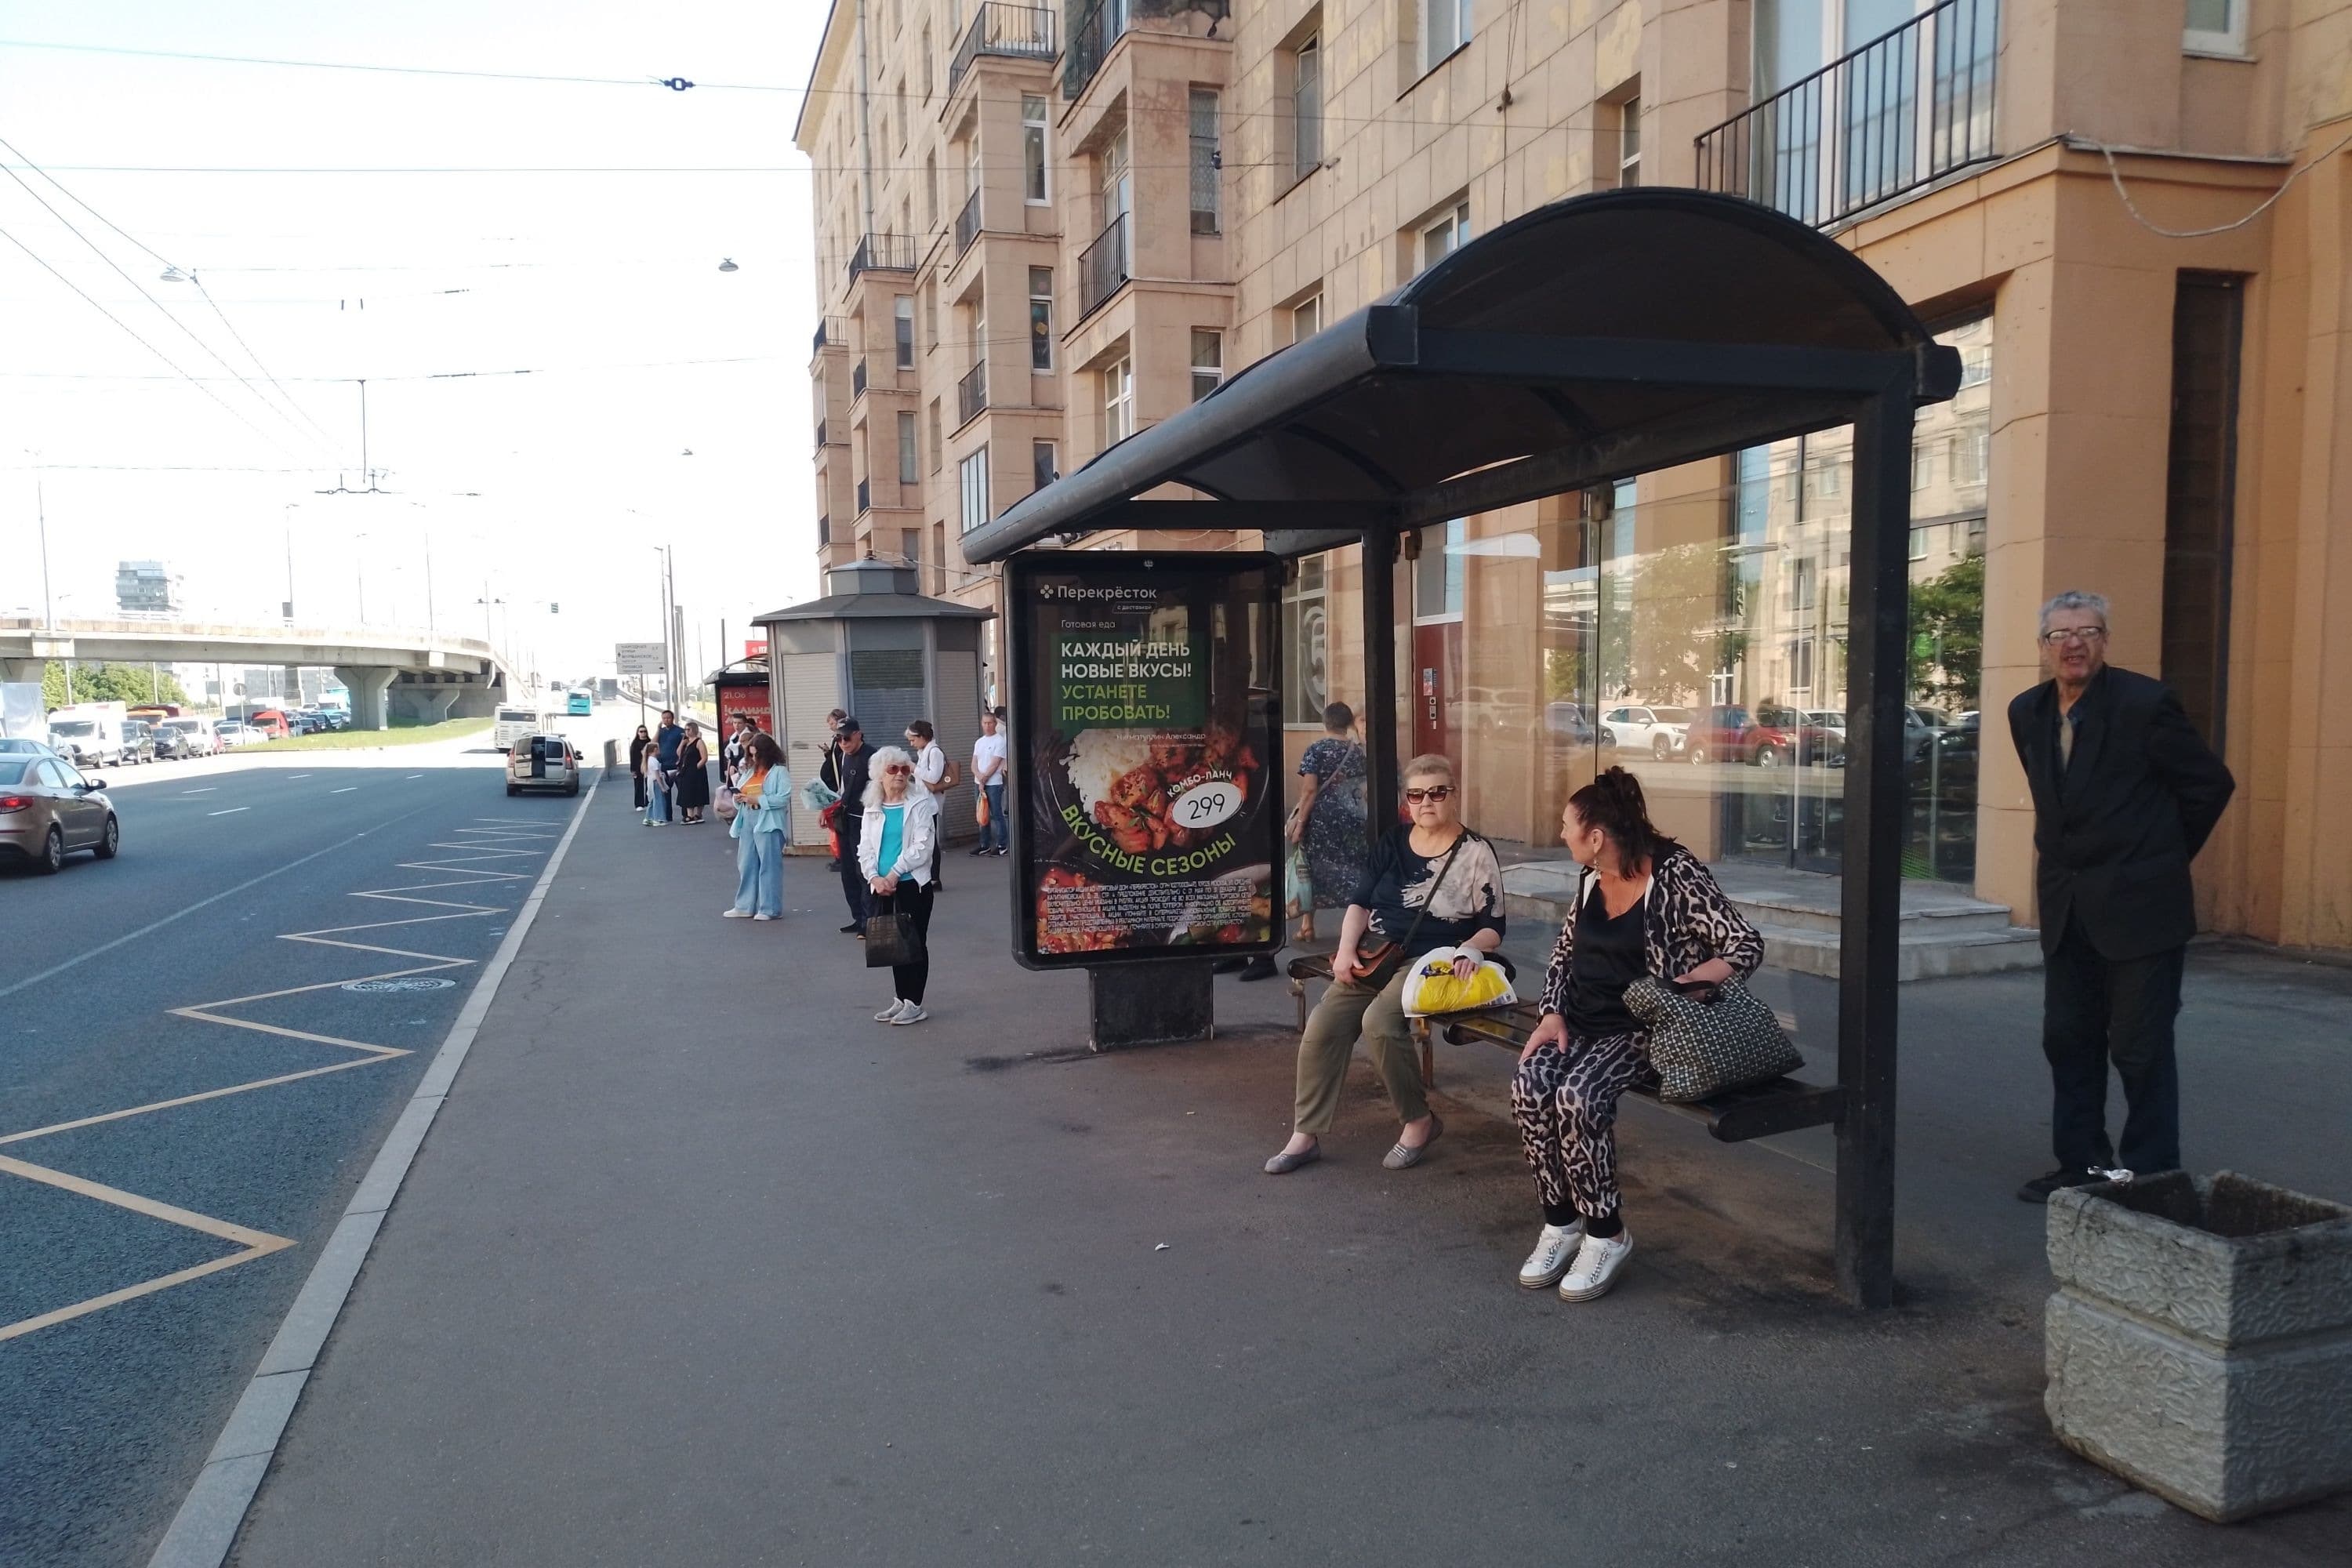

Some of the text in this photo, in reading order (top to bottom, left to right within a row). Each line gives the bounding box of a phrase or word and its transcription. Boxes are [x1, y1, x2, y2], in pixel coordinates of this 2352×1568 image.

[1058, 586, 1157, 601] Перекрёсток
[1061, 619, 1097, 629] Готовая
[1061, 639, 1190, 659] КАЖДЫЙ ДЕНЬ
[1061, 662, 1192, 678] НОВЫЕ ВКУСЫ!
[1062, 684, 1146, 699] УСТАНЕТЕ
[1062, 704, 1171, 720] ПРОБОВАТЬ!
[1166, 732, 1206, 741] Александр
[1167, 770, 1233, 798] КОМБО-ЛАНЧ
[1187, 793, 1225, 820] 299
[1061, 804, 1237, 876] ВКУСНЫЕ СЕЗОНЫ
